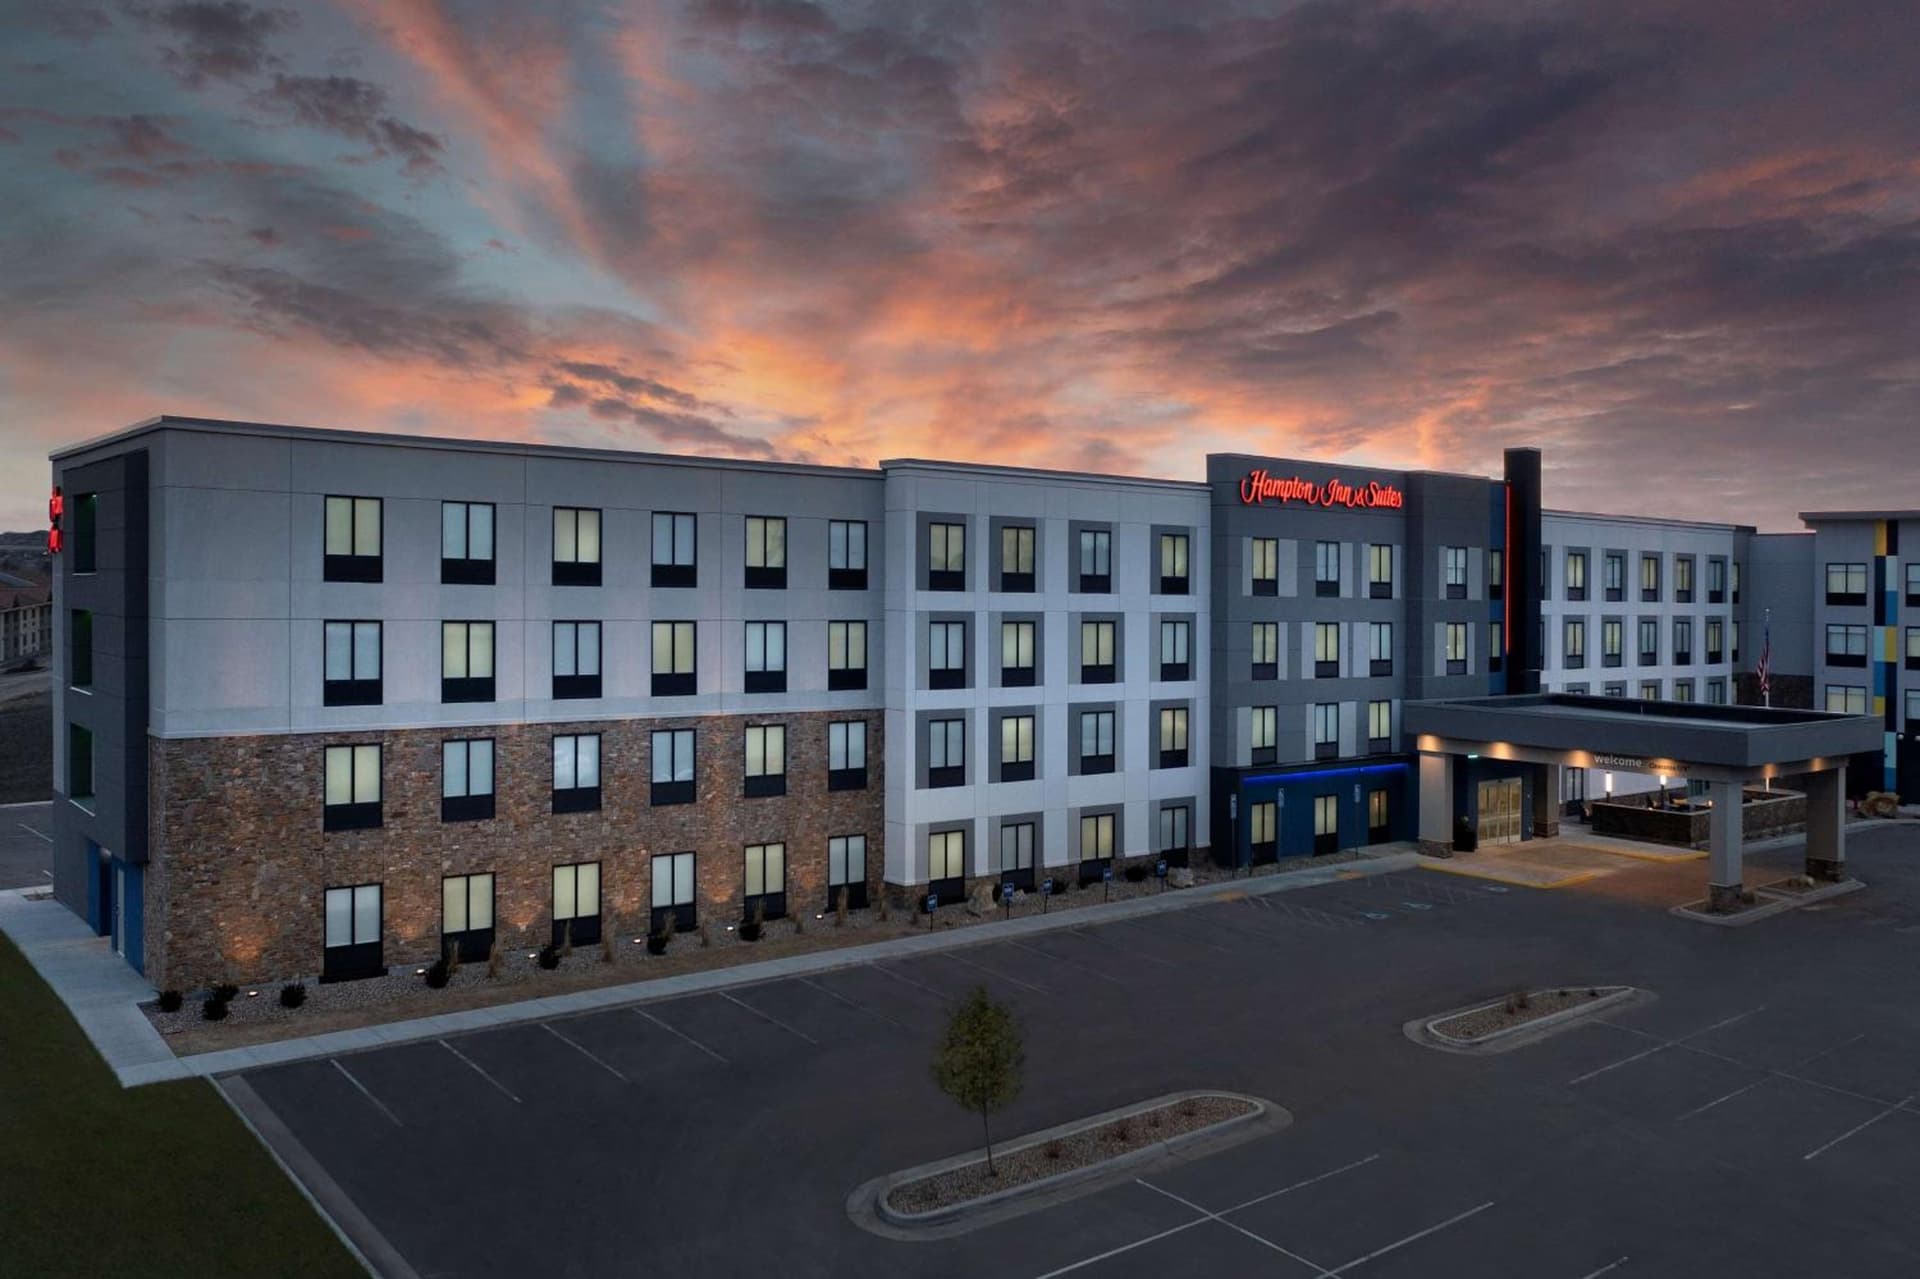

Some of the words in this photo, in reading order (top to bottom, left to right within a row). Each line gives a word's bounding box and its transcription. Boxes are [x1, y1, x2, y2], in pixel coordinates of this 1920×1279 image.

[1241, 470, 1319, 504] Hampton
[1321, 479, 1357, 507] Inn
[1356, 489, 1366, 507] &
[1365, 481, 1402, 508] Suites
[1593, 754, 1642, 768] welcome
